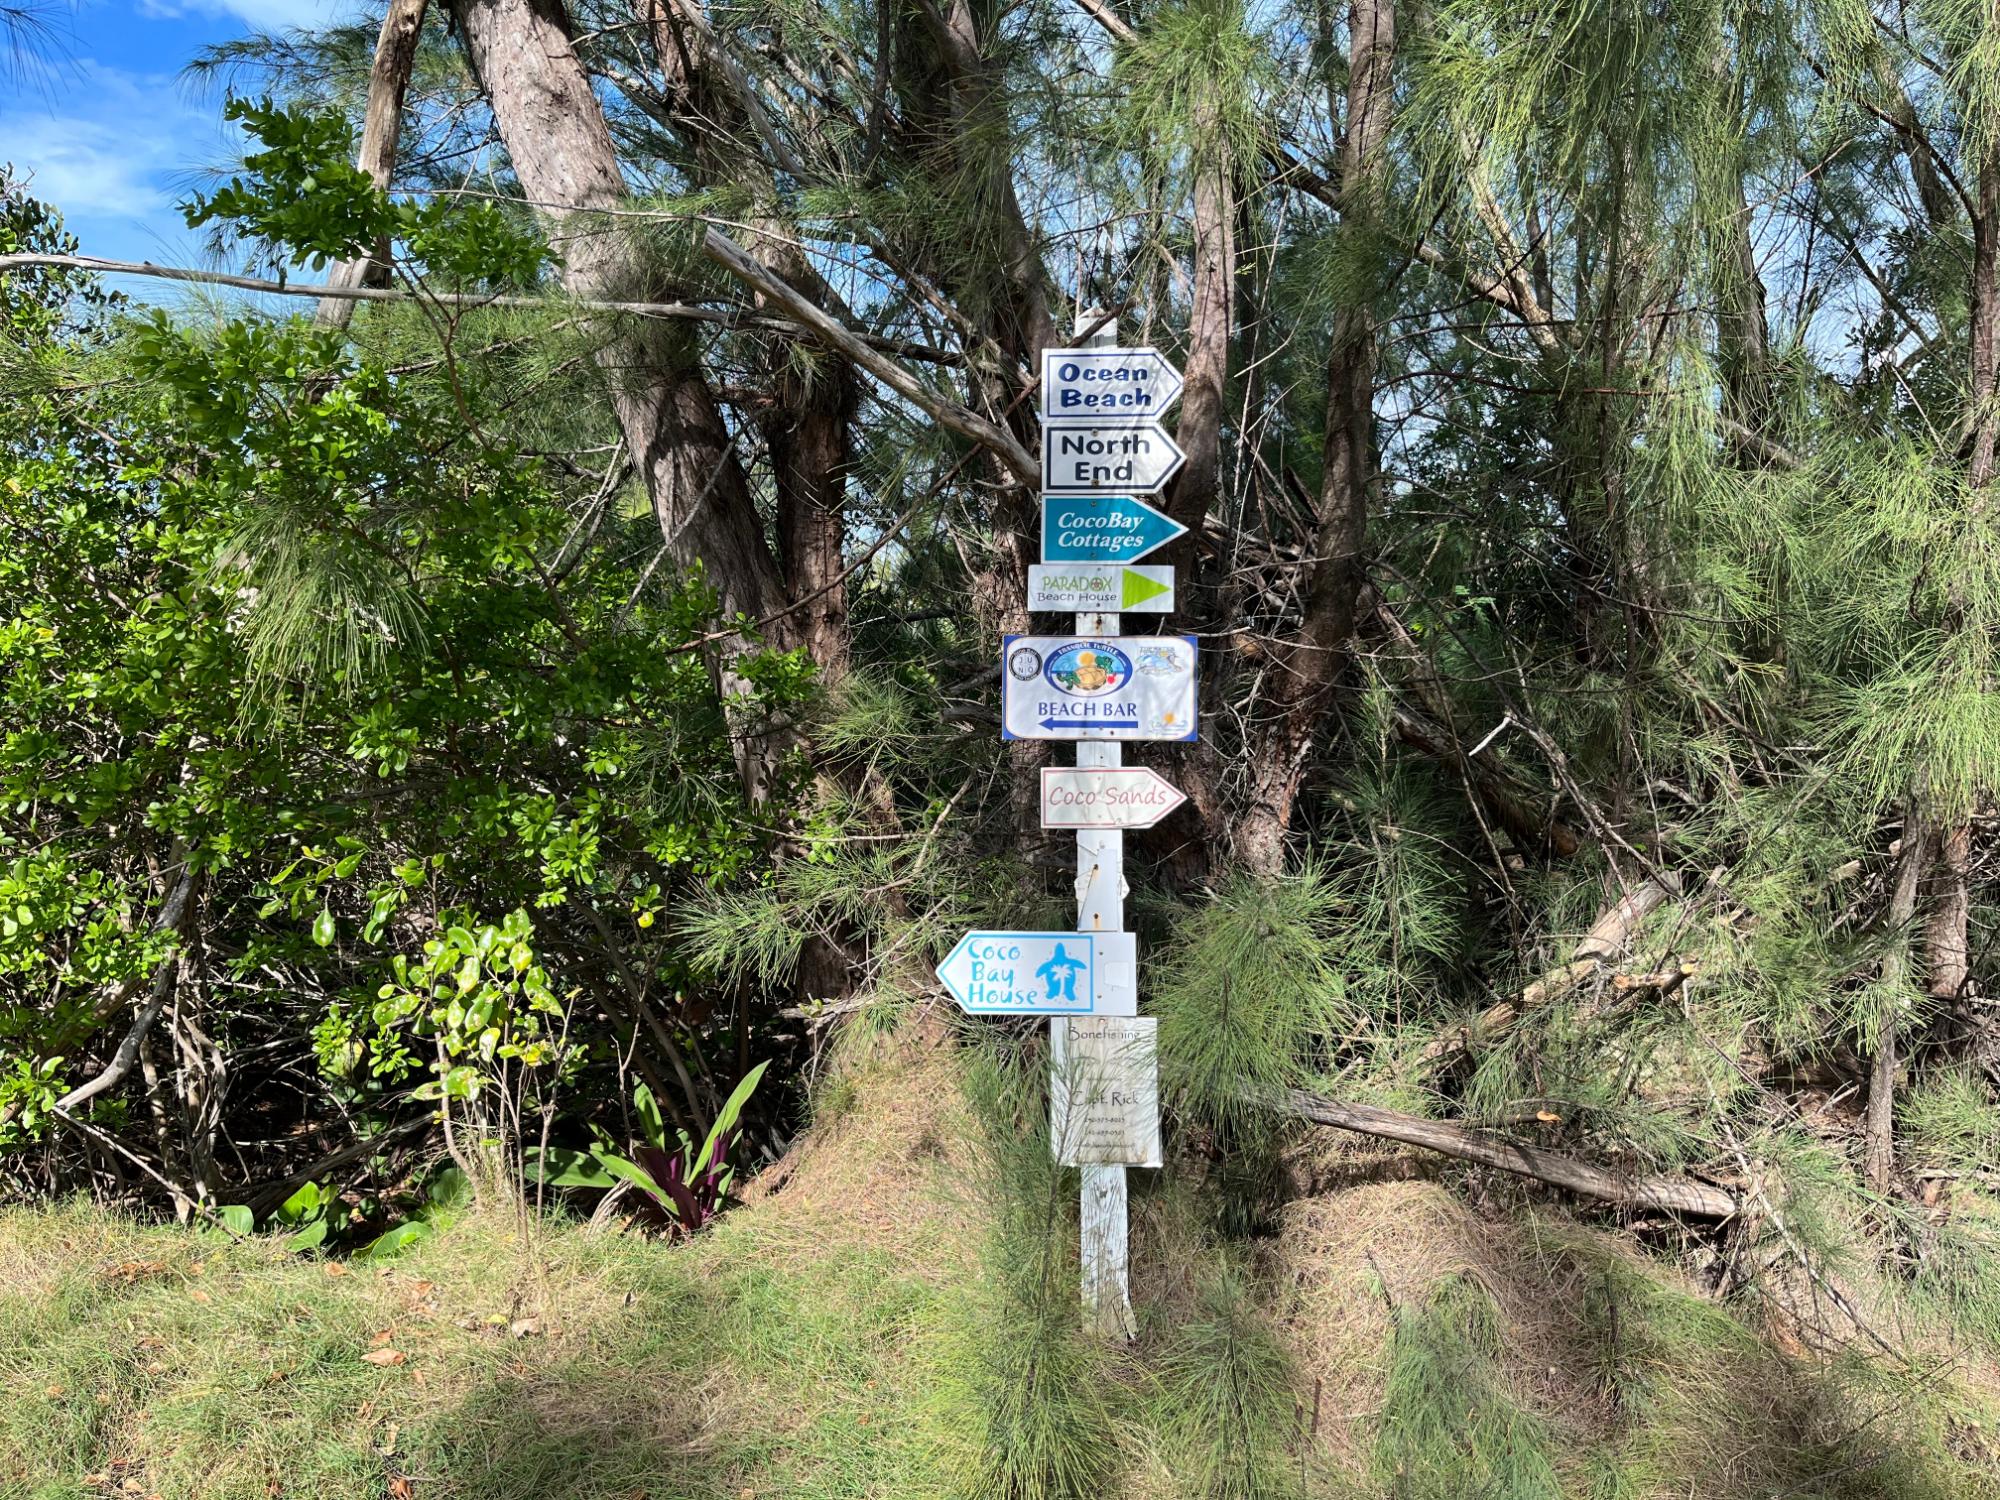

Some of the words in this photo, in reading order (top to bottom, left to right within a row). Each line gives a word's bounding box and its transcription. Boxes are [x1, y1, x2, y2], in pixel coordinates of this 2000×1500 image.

[1058, 363, 1148, 382] Ocean
[1060, 388, 1152, 408] Beach
[1061, 434, 1150, 455] North
[1075, 460, 1133, 481] End
[1058, 512, 1144, 533] CocoBay
[1058, 531, 1144, 552] Cottages
[1042, 575, 1113, 592] PARADOX
[1037, 592, 1075, 602] Beach
[1078, 592, 1117, 602] House
[1038, 702, 1096, 716] BEACH
[1103, 702, 1137, 717] BAR
[1050, 786, 1096, 806] Coco
[1103, 785, 1168, 806] Sands
[968, 940, 1021, 960] Coco
[971, 961, 1014, 989] Bay
[968, 983, 1038, 1005] House
[1071, 1090, 1108, 1109] Cpt.
[1111, 1090, 1138, 1107] Rick
